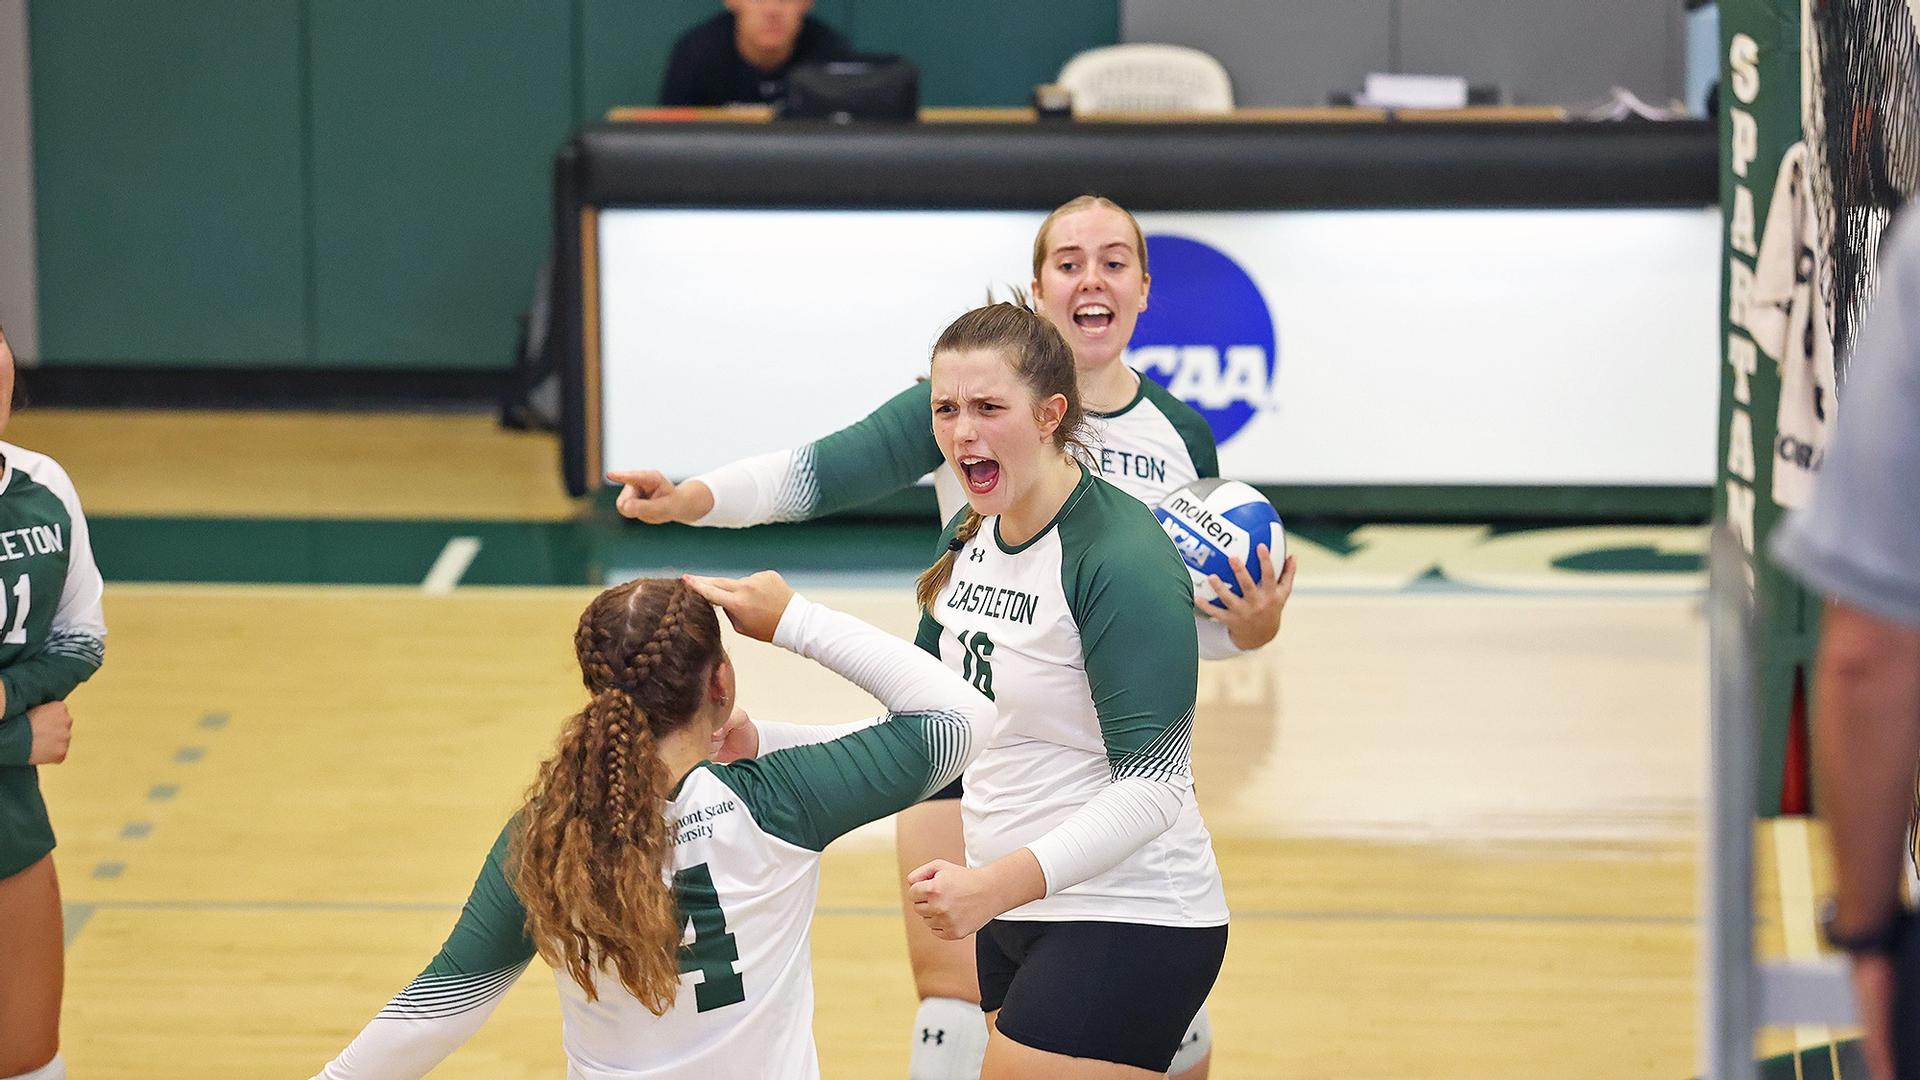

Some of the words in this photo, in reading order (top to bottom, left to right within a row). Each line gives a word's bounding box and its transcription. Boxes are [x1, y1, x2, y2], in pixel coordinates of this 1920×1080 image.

[1725, 32, 1761, 605] SPARTAN
[1122, 344, 1276, 411] CAA
[1101, 448, 1165, 483] ETON
[1170, 497, 1233, 547] molten
[947, 580, 1039, 625] CASTLETON
[957, 629, 996, 703] 16
[704, 800, 735, 820] State
[673, 862, 746, 1013] 4
